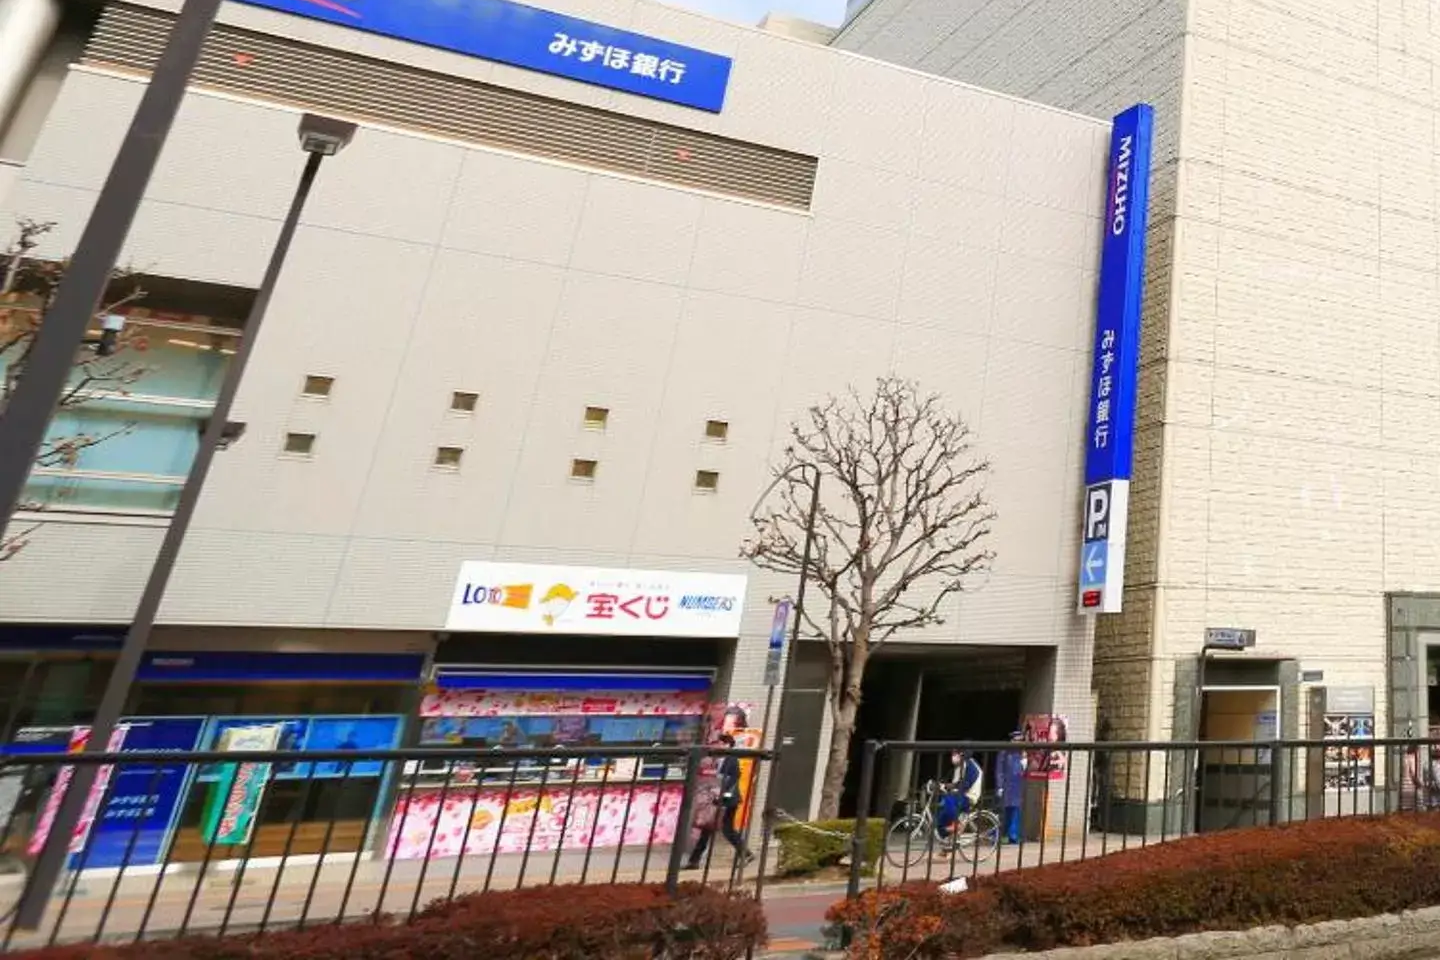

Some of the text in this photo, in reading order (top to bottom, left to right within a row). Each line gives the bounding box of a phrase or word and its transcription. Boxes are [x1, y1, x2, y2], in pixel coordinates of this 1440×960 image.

[548, 32, 687, 85] みずほ銀行
[1112, 135, 1133, 236] MIZUHO
[1093, 328, 1116, 449] みずほ銀行
[1087, 488, 1108, 539] P
[586, 592, 670, 620] 宝くじ
[679, 594, 738, 612] NUMBERS
